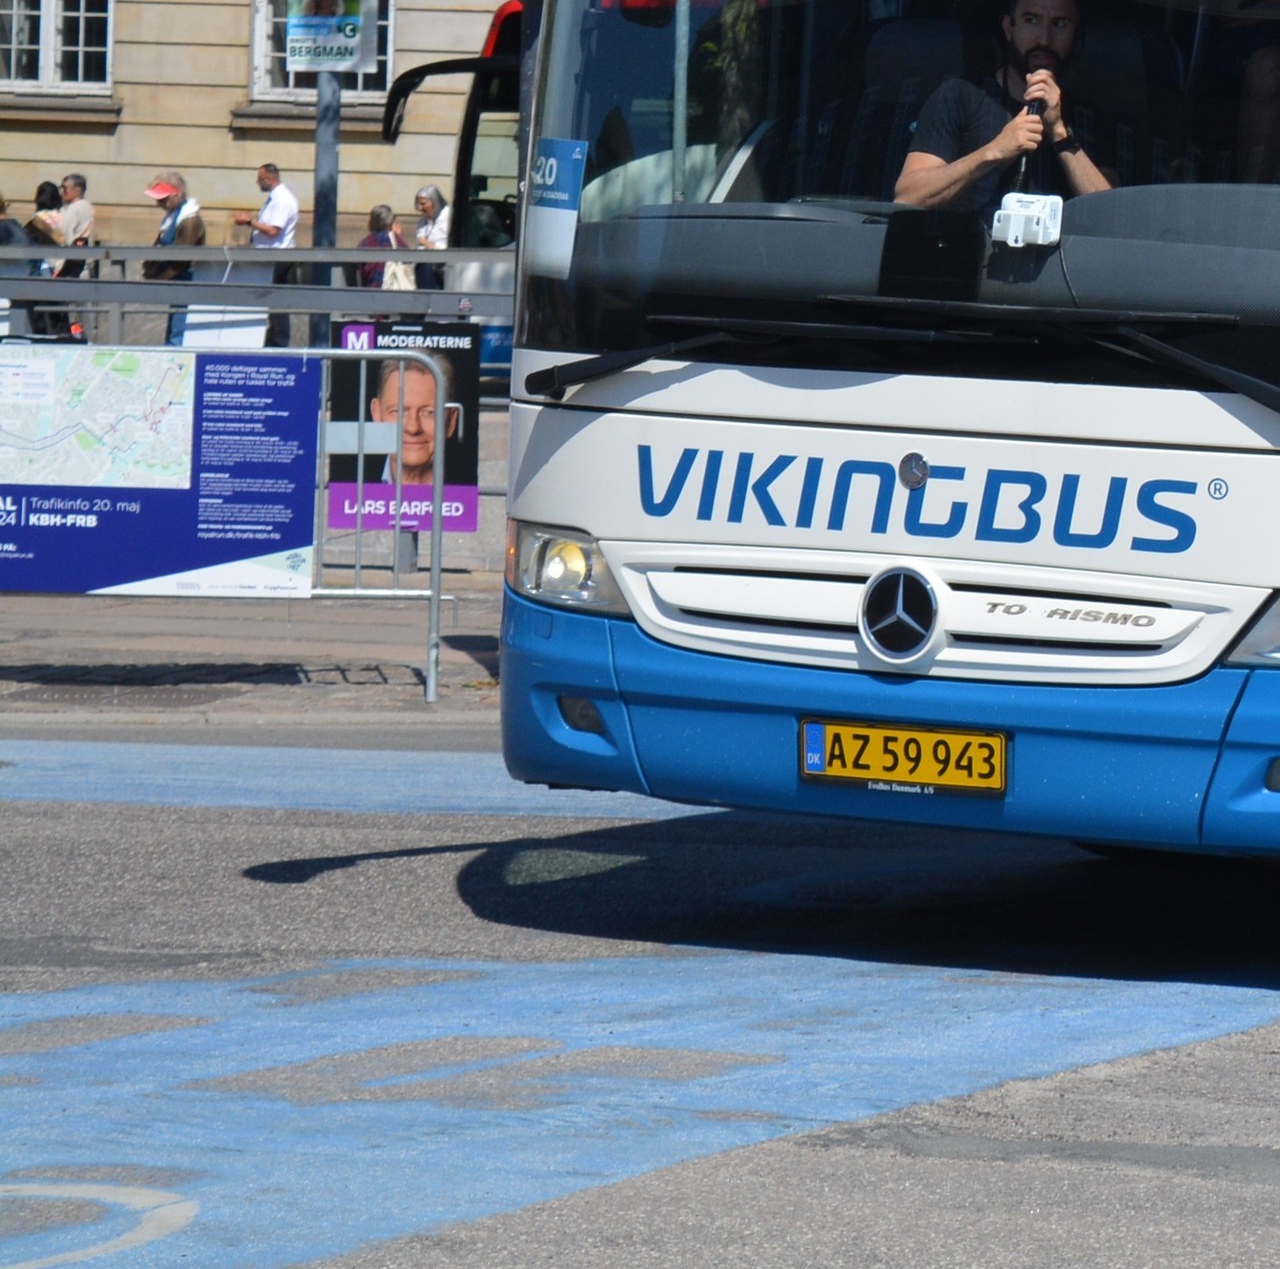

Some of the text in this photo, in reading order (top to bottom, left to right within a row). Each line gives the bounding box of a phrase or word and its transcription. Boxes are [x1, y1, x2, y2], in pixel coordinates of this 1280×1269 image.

[289, 45, 354, 57] BERGMAN
[347, 332, 369, 349] M
[377, 335, 472, 349] MODERATERNE
[30, 496, 141, 514] Trafikinfo 20. maj
[389, 501, 464, 517] BARFED
[28, 513, 98, 528] KBH-FRB
[807, 752, 822, 765] DK
[892, 784, 921, 794] Danmark
